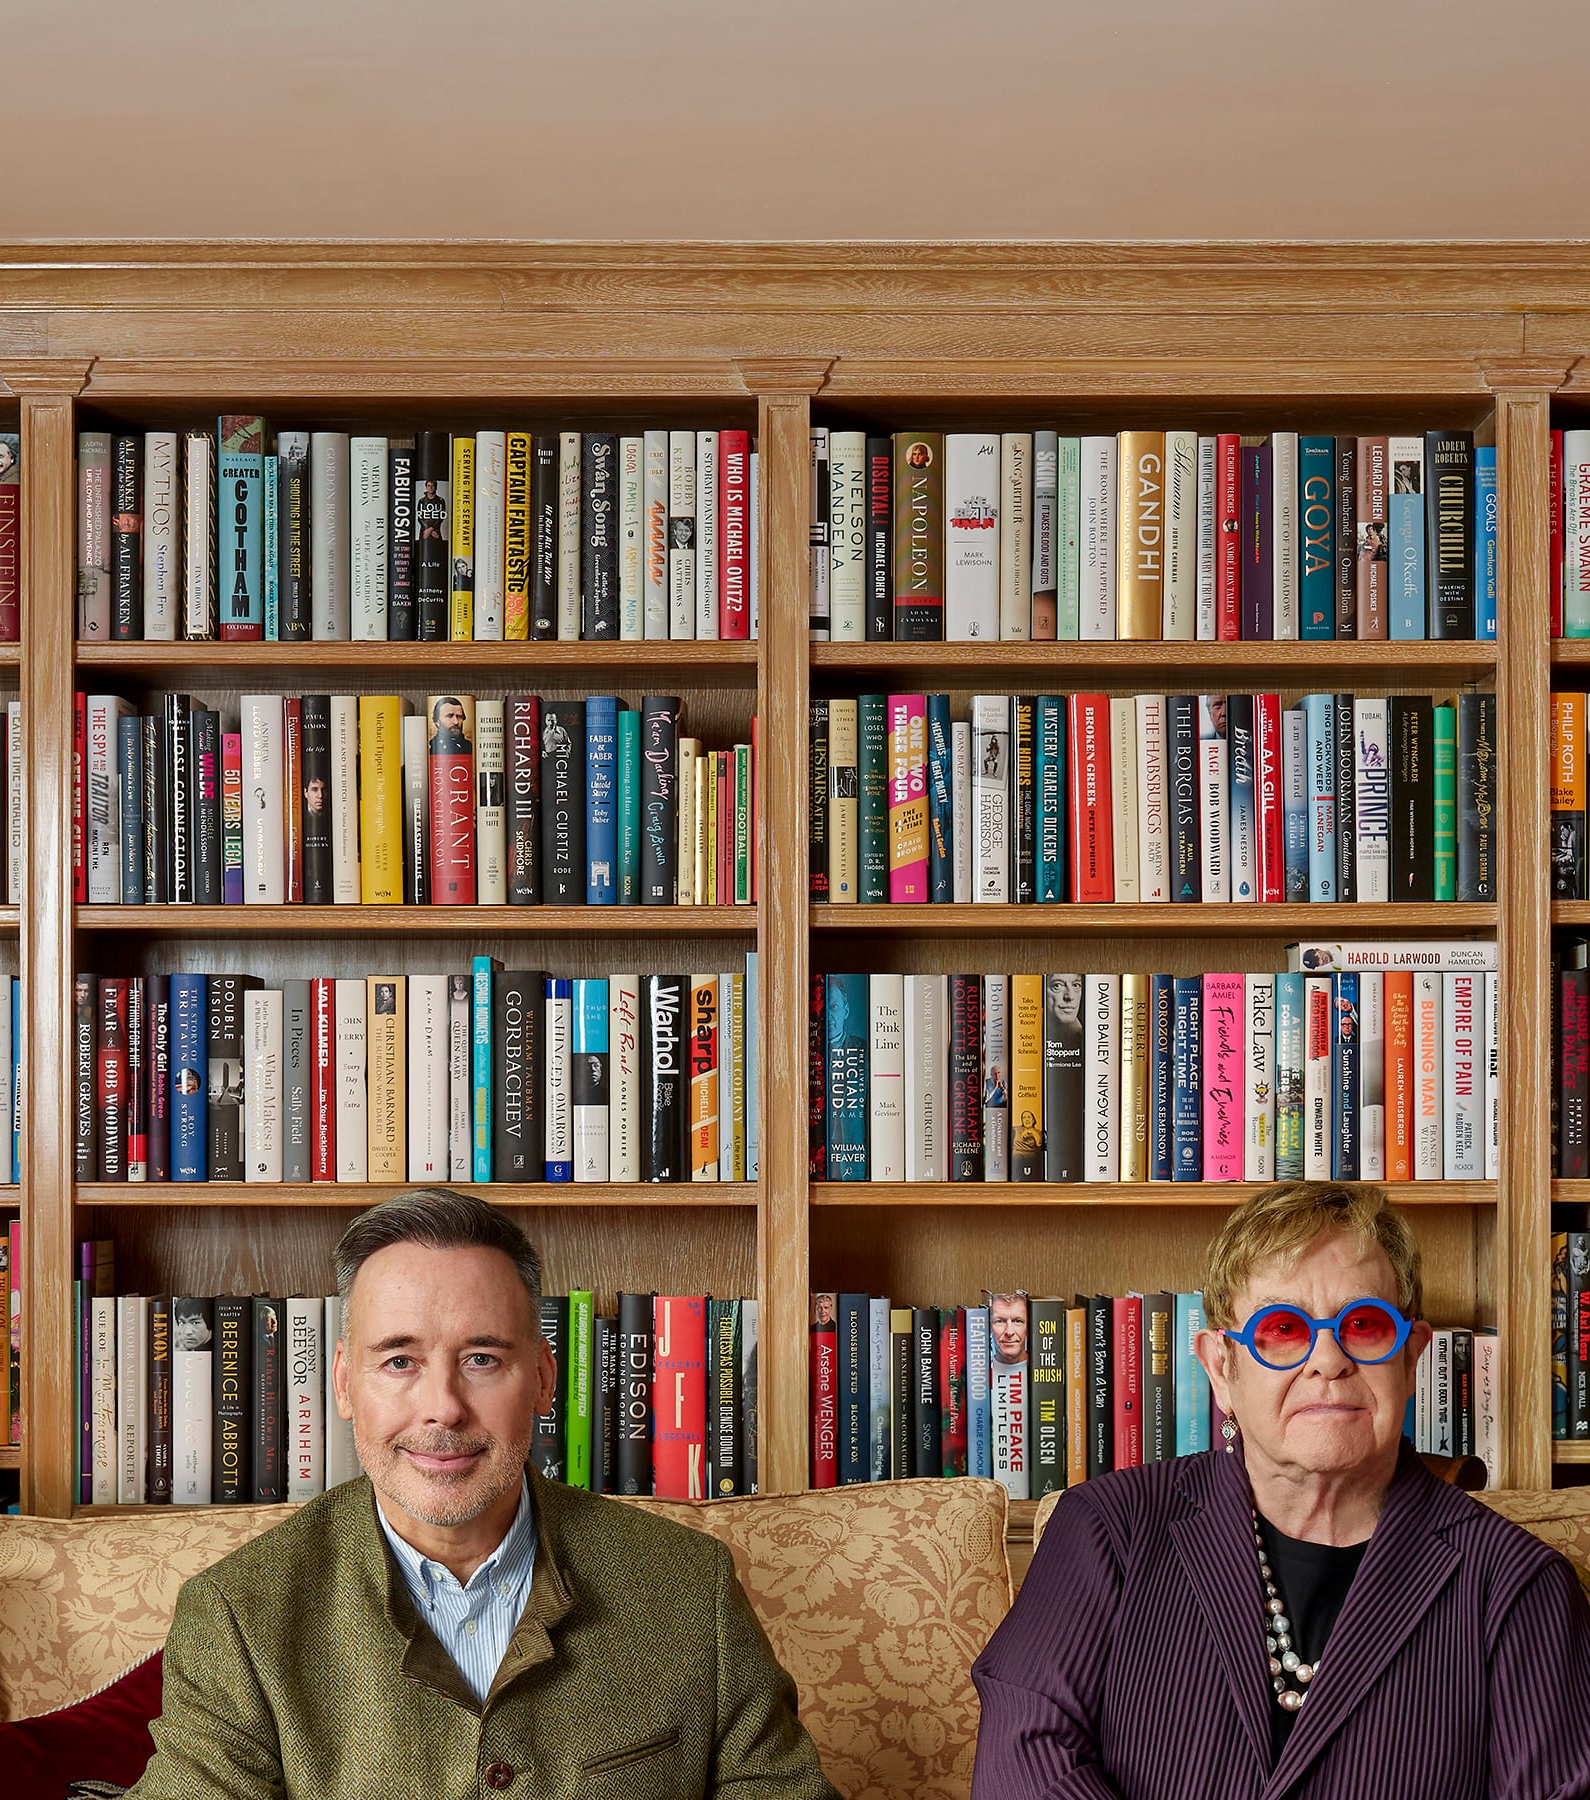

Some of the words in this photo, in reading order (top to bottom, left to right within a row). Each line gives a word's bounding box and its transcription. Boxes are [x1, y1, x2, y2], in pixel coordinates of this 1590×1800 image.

[152, 440, 170, 535] MYTHOS
[223, 468, 260, 478] GREATER
[394, 458, 410, 542] FABULOSA!
[508, 438, 526, 504] CAPTAIN
[832, 462, 845, 571] MANDELA
[850, 470, 862, 562] NELSON
[912, 476, 927, 591] NAPOLEON
[1138, 453, 1161, 581] GANDHI
[1304, 476, 1331, 576] GOYA
[1440, 475, 1463, 574] CHURCHILL
[232, 480, 249, 618] GOTHAM
[507, 509, 526, 592] FANTASTIC
[1145, 703, 1159, 734] THE
[225, 768, 241, 785] 50
[556, 744, 567, 807] MICHAEL
[1146, 740, 1162, 835] HABSBURGS
[225, 793, 241, 830] YEARS
[450, 765, 470, 869] GRANT
[1358, 769, 1388, 841] PRINCE
[225, 835, 241, 872] LEGAL
[555, 811, 567, 862] CURTIZ
[1348, 952, 1389, 966] HAROLD
[1393, 952, 1440, 966] LARWOOD
[1448, 958, 1486, 966] HAMILTON
[1451, 950, 1483, 958] DUNCAN
[655, 986, 679, 1074] Warhol
[876, 1023, 899, 1033] Pink
[877, 1006, 898, 1016] The
[1252, 983, 1272, 1027] Fake
[1455, 978, 1471, 1032] EMPIRE
[506, 991, 522, 1138] GORBACHEV
[875, 1040, 899, 1050] Line
[1252, 1030, 1272, 1073] Law
[1455, 1040, 1471, 1058] OF
[1455, 1062, 1471, 1096] PAIN
[830, 1153, 865, 1162] FEAVER
[1039, 1321, 1056, 1334] SON
[1042, 1337, 1053, 1350] OF
[223, 1321, 238, 1401] BERENICE
[628, 1334, 646, 1441] EDISON
[971, 1317, 985, 1400] FEATHERHOOD
[1034, 1370, 1062, 1383] BRUSH
[1040, 1353, 1055, 1366] THE
[1009, 1372, 1022, 1404] TIM
[222, 1419, 238, 1486] ABBOTT
[298, 1394, 311, 1479] ARNHEM
[1009, 1410, 1022, 1472] PEAKE
